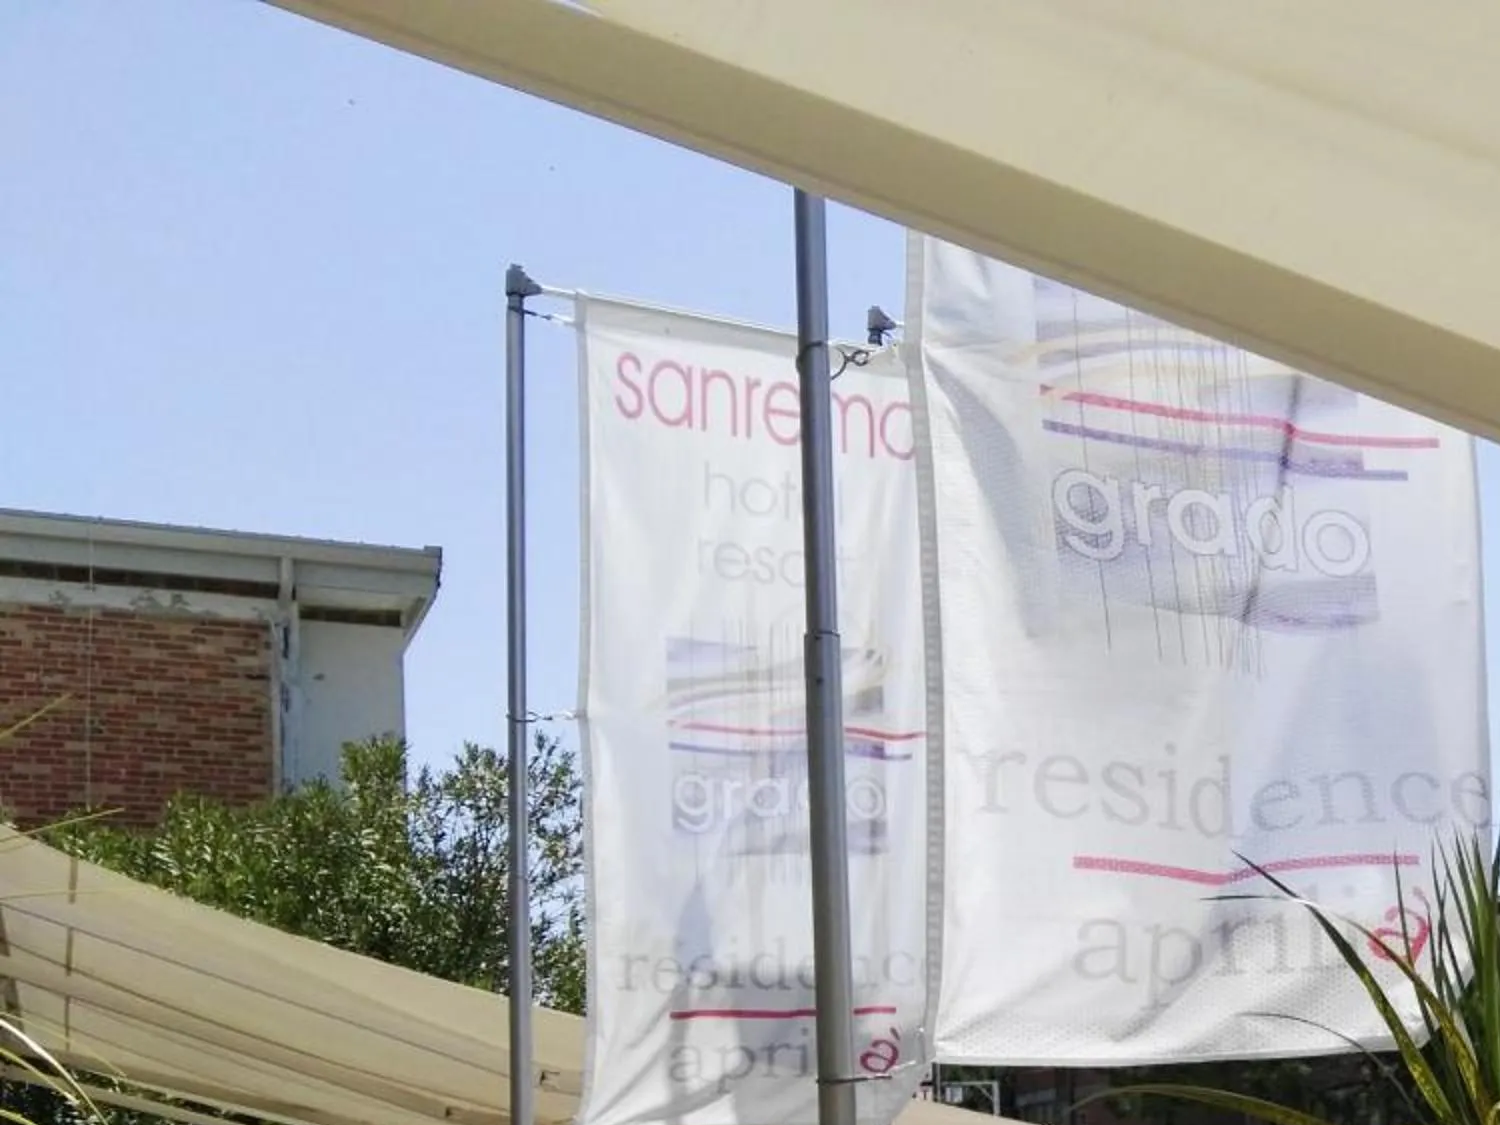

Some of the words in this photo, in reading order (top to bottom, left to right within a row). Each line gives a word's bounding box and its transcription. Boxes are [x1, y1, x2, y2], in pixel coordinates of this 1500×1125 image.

[1050, 466, 1372, 579] grado
[675, 772, 886, 834] grao
[956, 741, 1492, 839] residence
